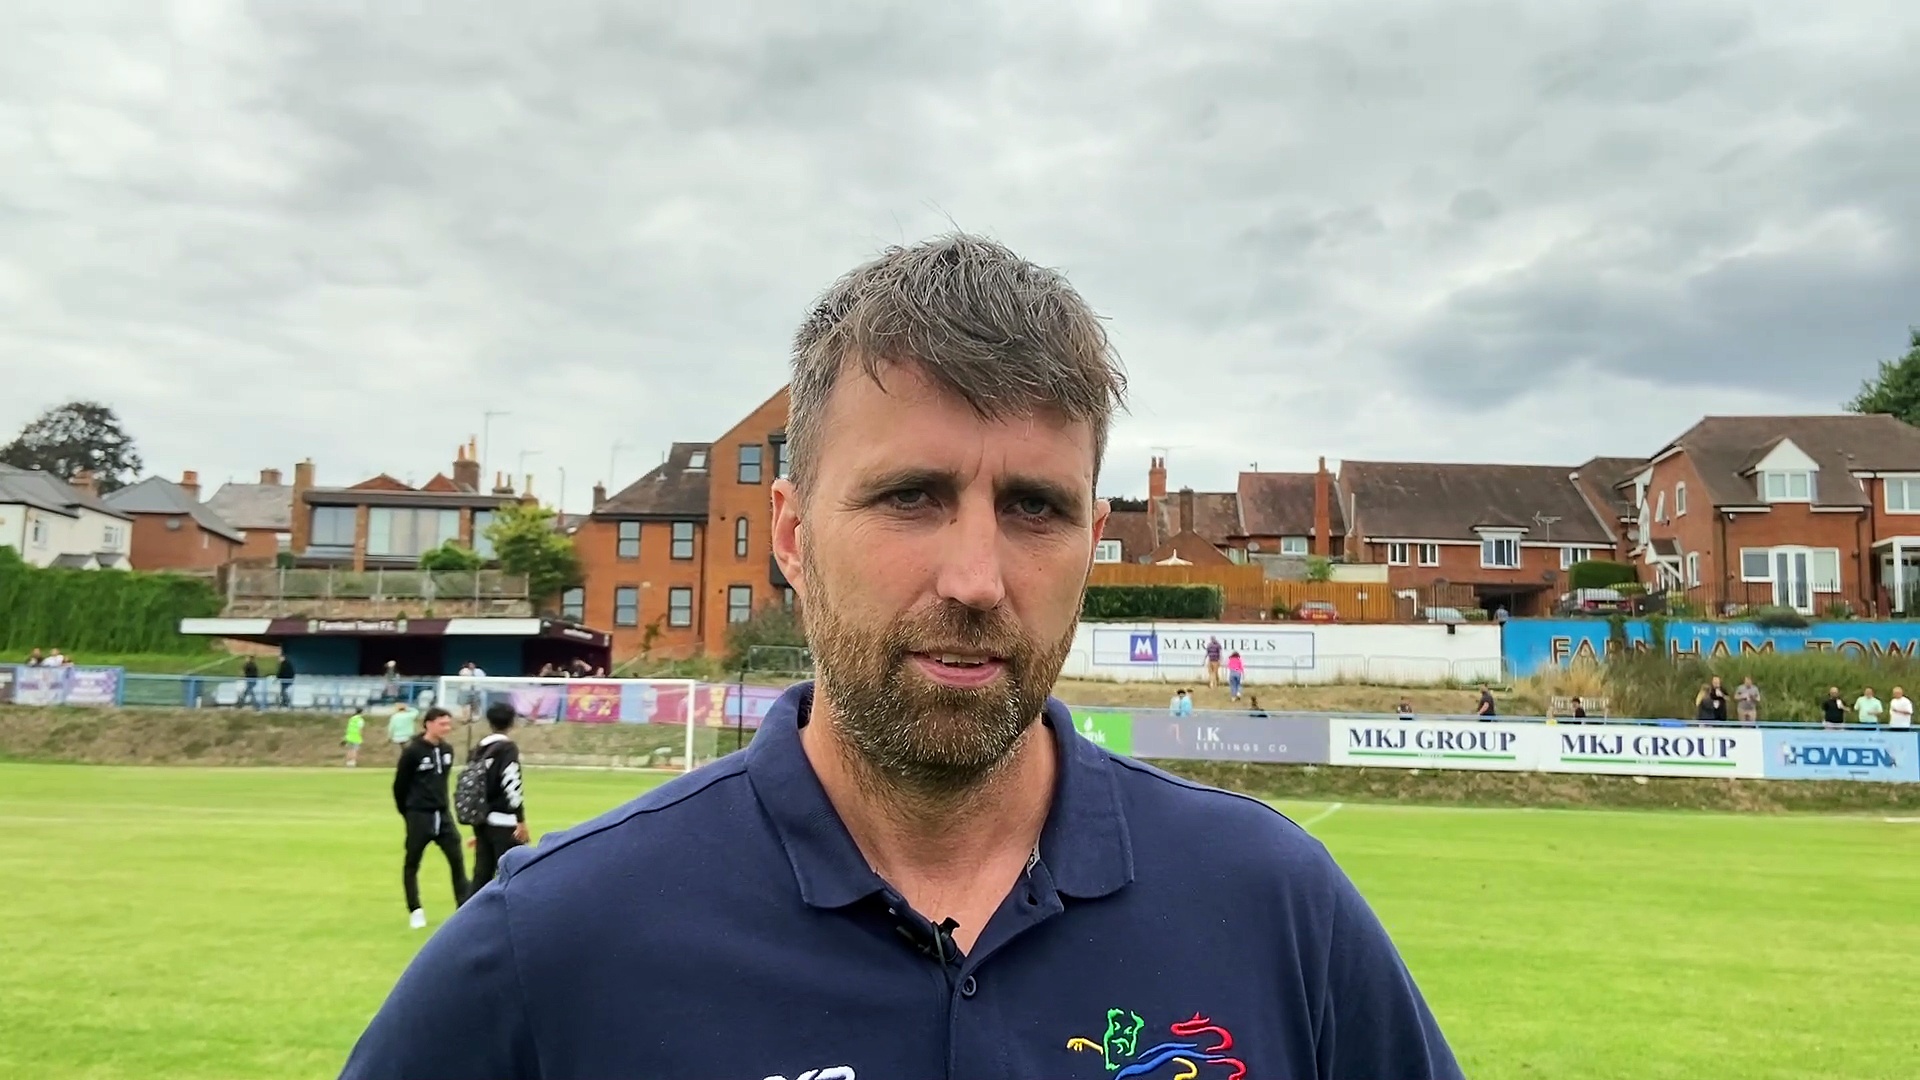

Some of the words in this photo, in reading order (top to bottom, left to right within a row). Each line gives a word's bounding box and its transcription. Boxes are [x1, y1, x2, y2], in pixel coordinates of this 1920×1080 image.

[1163, 638, 1277, 652] MARHELS
[1349, 728, 1406, 748] MKJ
[1415, 729, 1515, 751] GROUP
[1561, 734, 1623, 755] MKJ
[1632, 735, 1736, 758] GROUP
